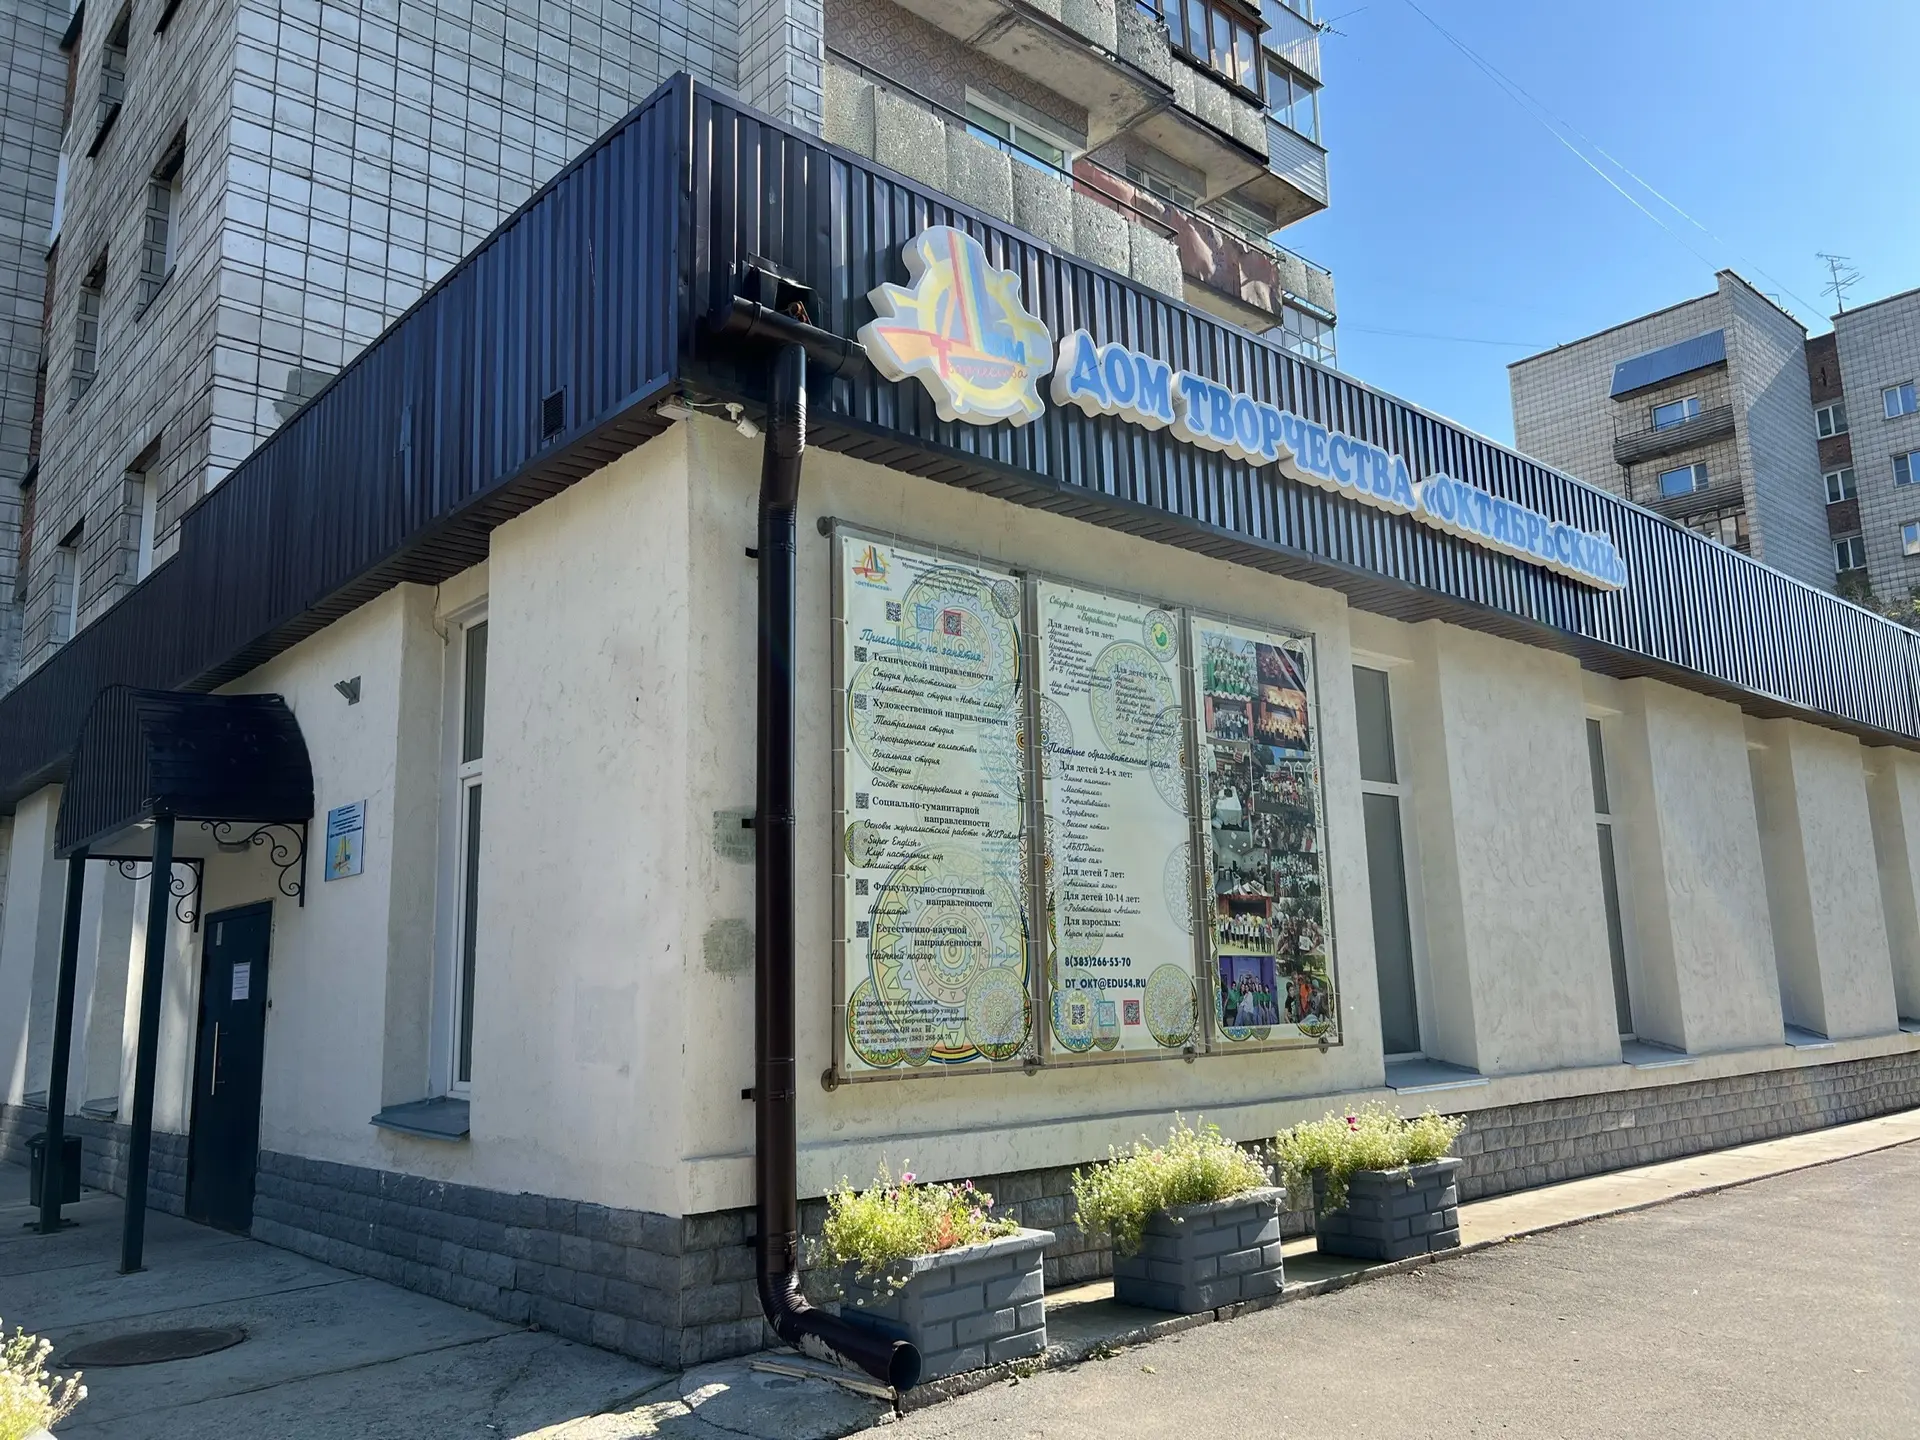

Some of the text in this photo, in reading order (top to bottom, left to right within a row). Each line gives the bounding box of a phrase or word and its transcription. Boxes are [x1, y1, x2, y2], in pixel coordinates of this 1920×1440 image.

[1071, 335, 1626, 587] ДОМ ТВОРЧЕСТВА «ОКТЯБРЬСКИЙ»
[1049, 594, 1074, 610] Студия
[1048, 618, 1062, 629] Для
[1063, 624, 1083, 634] детей
[860, 628, 922, 651] Приглашаем
[927, 645, 937, 654] на
[872, 652, 994, 681] Технической направленности
[873, 667, 957, 689] Студия робототехники
[872, 681, 924, 698] Мультимедиа
[927, 691, 952, 702] студия
[873, 698, 943, 716] Художественной
[945, 711, 1009, 727] направленности
[874, 715, 955, 736] Театральная студия
[870, 732, 977, 753] Хореографические коллективы
[872, 749, 940, 767] Вокальная студия
[1048, 742, 1170, 771] Платные образовательные услуги
[872, 762, 912, 776] Изостудии
[1059, 760, 1133, 779] Для детей 2-4-х лет:
[871, 777, 898, 789] Основы
[901, 783, 962, 796] конструирования
[972, 791, 999, 799] дизайна
[872, 796, 980, 815] Социально-гуманитарной
[864, 818, 891, 830] Основы
[894, 824, 950, 835] журналистской
[951, 828, 978, 839] работы
[924, 815, 990, 828] направленности
[863, 834, 921, 849] «Super English»
[866, 846, 943, 863] Клуб настольных игр
[863, 858, 927, 872] Английский язык
[1062, 865, 1125, 879] Для детей 7 лет:
[873, 882, 985, 896] Физкультурно-спортивной
[1063, 890, 1079, 902] Для
[1080, 893, 1103, 902] детей
[1105, 893, 1124, 902] 10-14
[868, 904, 908, 915] Шахматы
[926, 899, 993, 907] направленности
[876, 924, 967, 935] Естественно-научной
[1063, 916, 1121, 928] Для взрослых:
[914, 939, 982, 948] направленности
[1064, 955, 1131, 967] 8(383)266-53-70
[1064, 977, 1147, 990] DT_OKT@EDU54.RU
